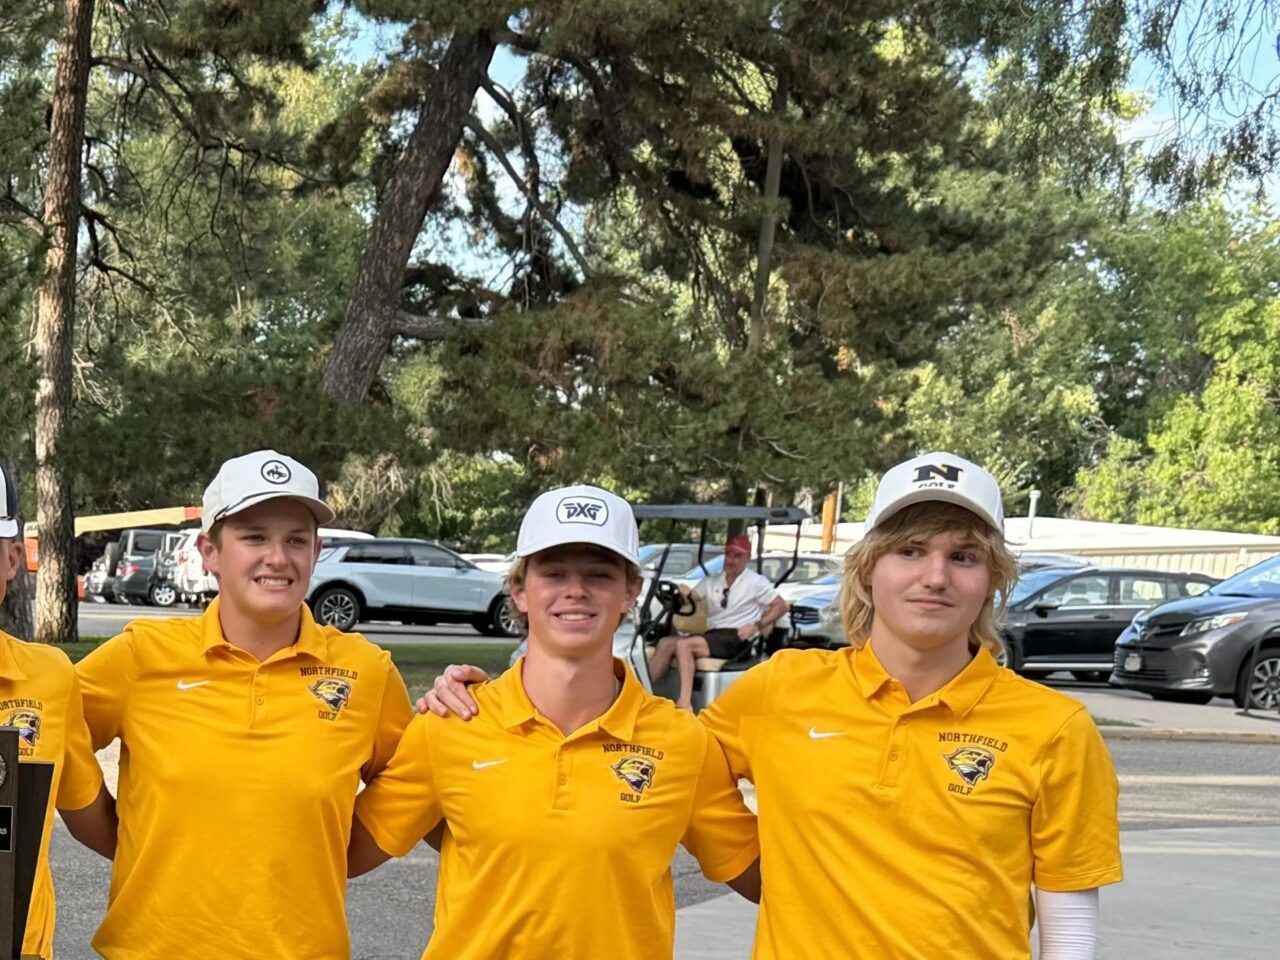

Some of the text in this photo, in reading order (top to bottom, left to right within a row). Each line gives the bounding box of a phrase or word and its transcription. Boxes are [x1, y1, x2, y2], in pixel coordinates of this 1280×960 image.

[912, 463, 964, 482] N
[563, 503, 603, 520] PXG
[300, 666, 358, 680] NORTHFIELD
[318, 710, 337, 721] GOLF
[938, 732, 1008, 752] NORTHFIELD
[602, 743, 664, 760] NORTHFIELD
[948, 783, 973, 796] GOLF
[620, 792, 641, 803] GOLF
